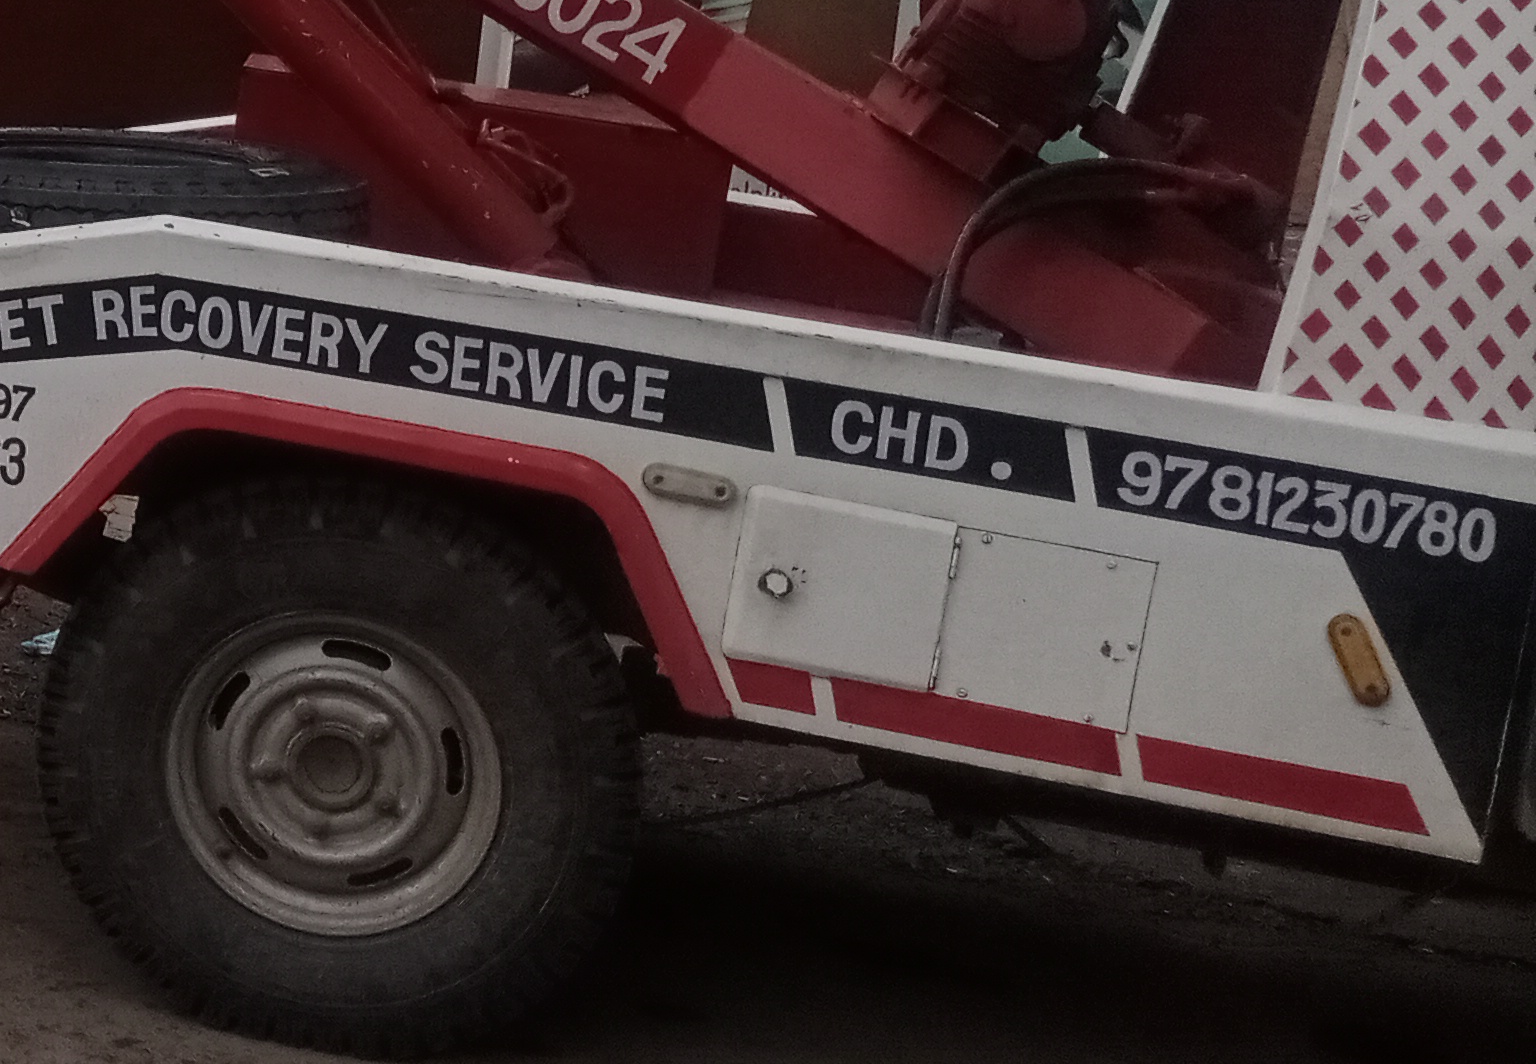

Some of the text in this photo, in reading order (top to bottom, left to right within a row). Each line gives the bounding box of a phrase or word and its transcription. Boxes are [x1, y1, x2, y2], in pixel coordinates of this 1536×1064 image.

[92, 286, 388, 373] RECOVERY
[409, 331, 671, 423] SERVICE
[1117, 450, 1498, 563] 9781230780
